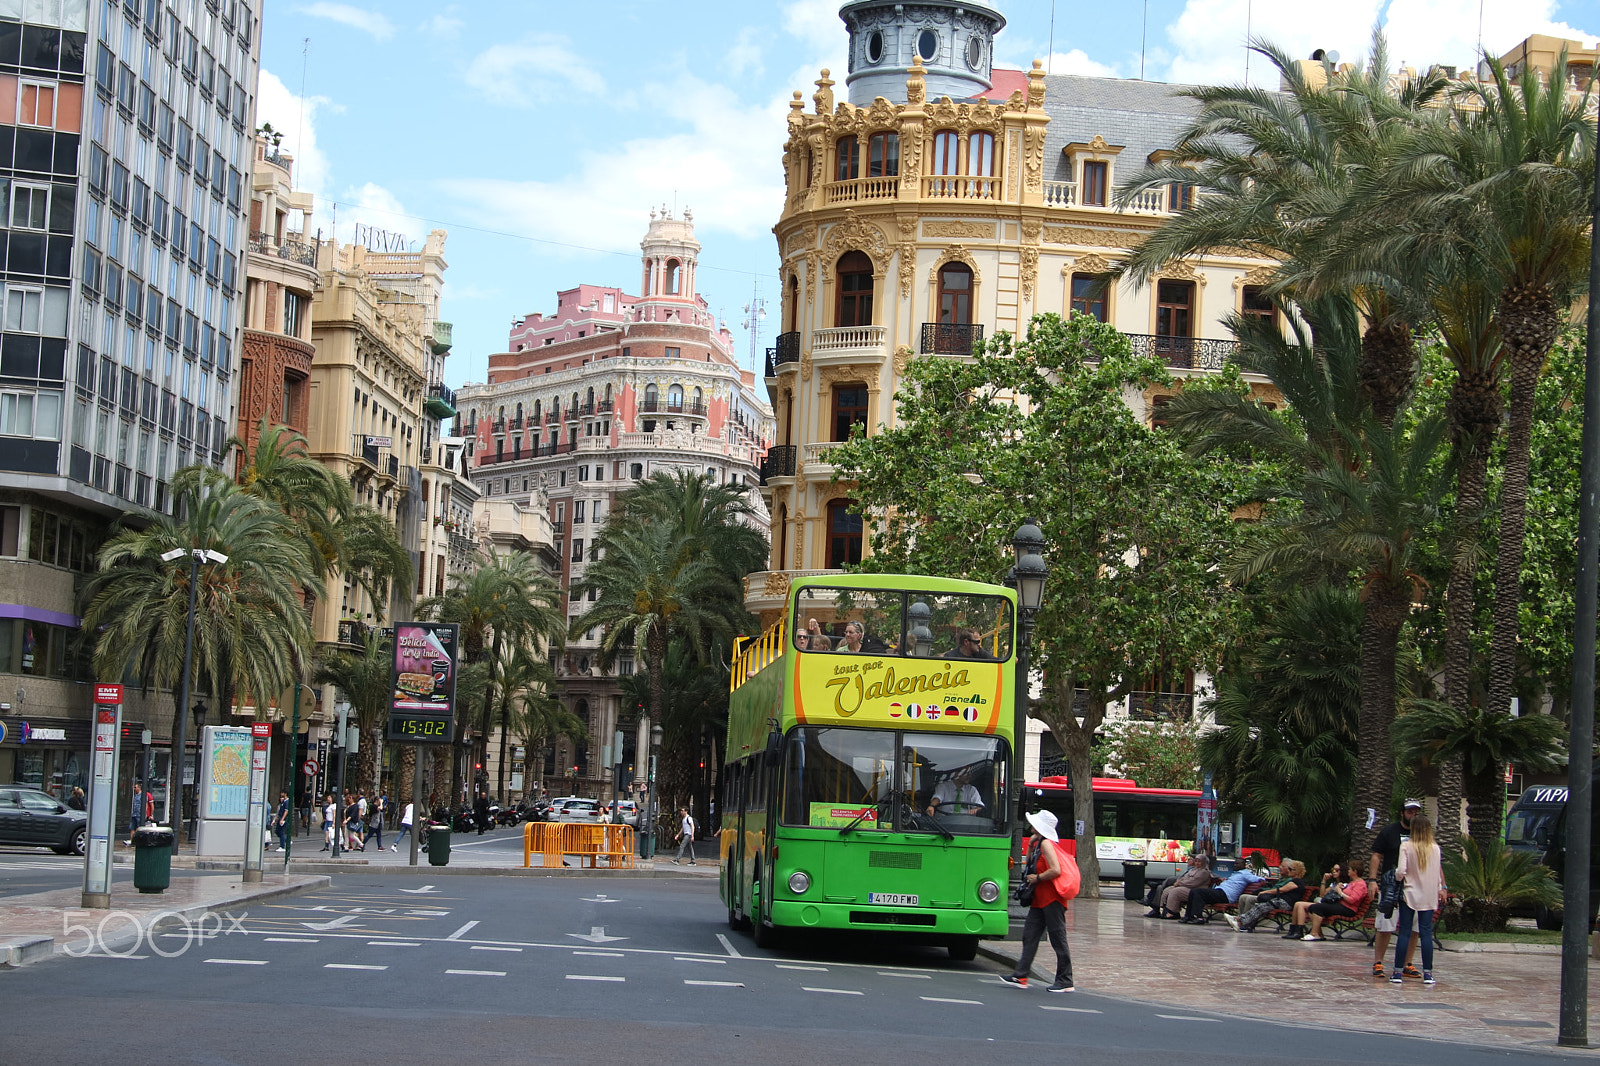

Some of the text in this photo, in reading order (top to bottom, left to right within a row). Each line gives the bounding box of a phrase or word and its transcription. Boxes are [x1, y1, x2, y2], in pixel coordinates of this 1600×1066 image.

[355, 222, 409, 253] BBVA
[825, 663, 970, 717] Valencia
[402, 720, 446, 735] 15:02
[875, 894, 899, 904] 4170
